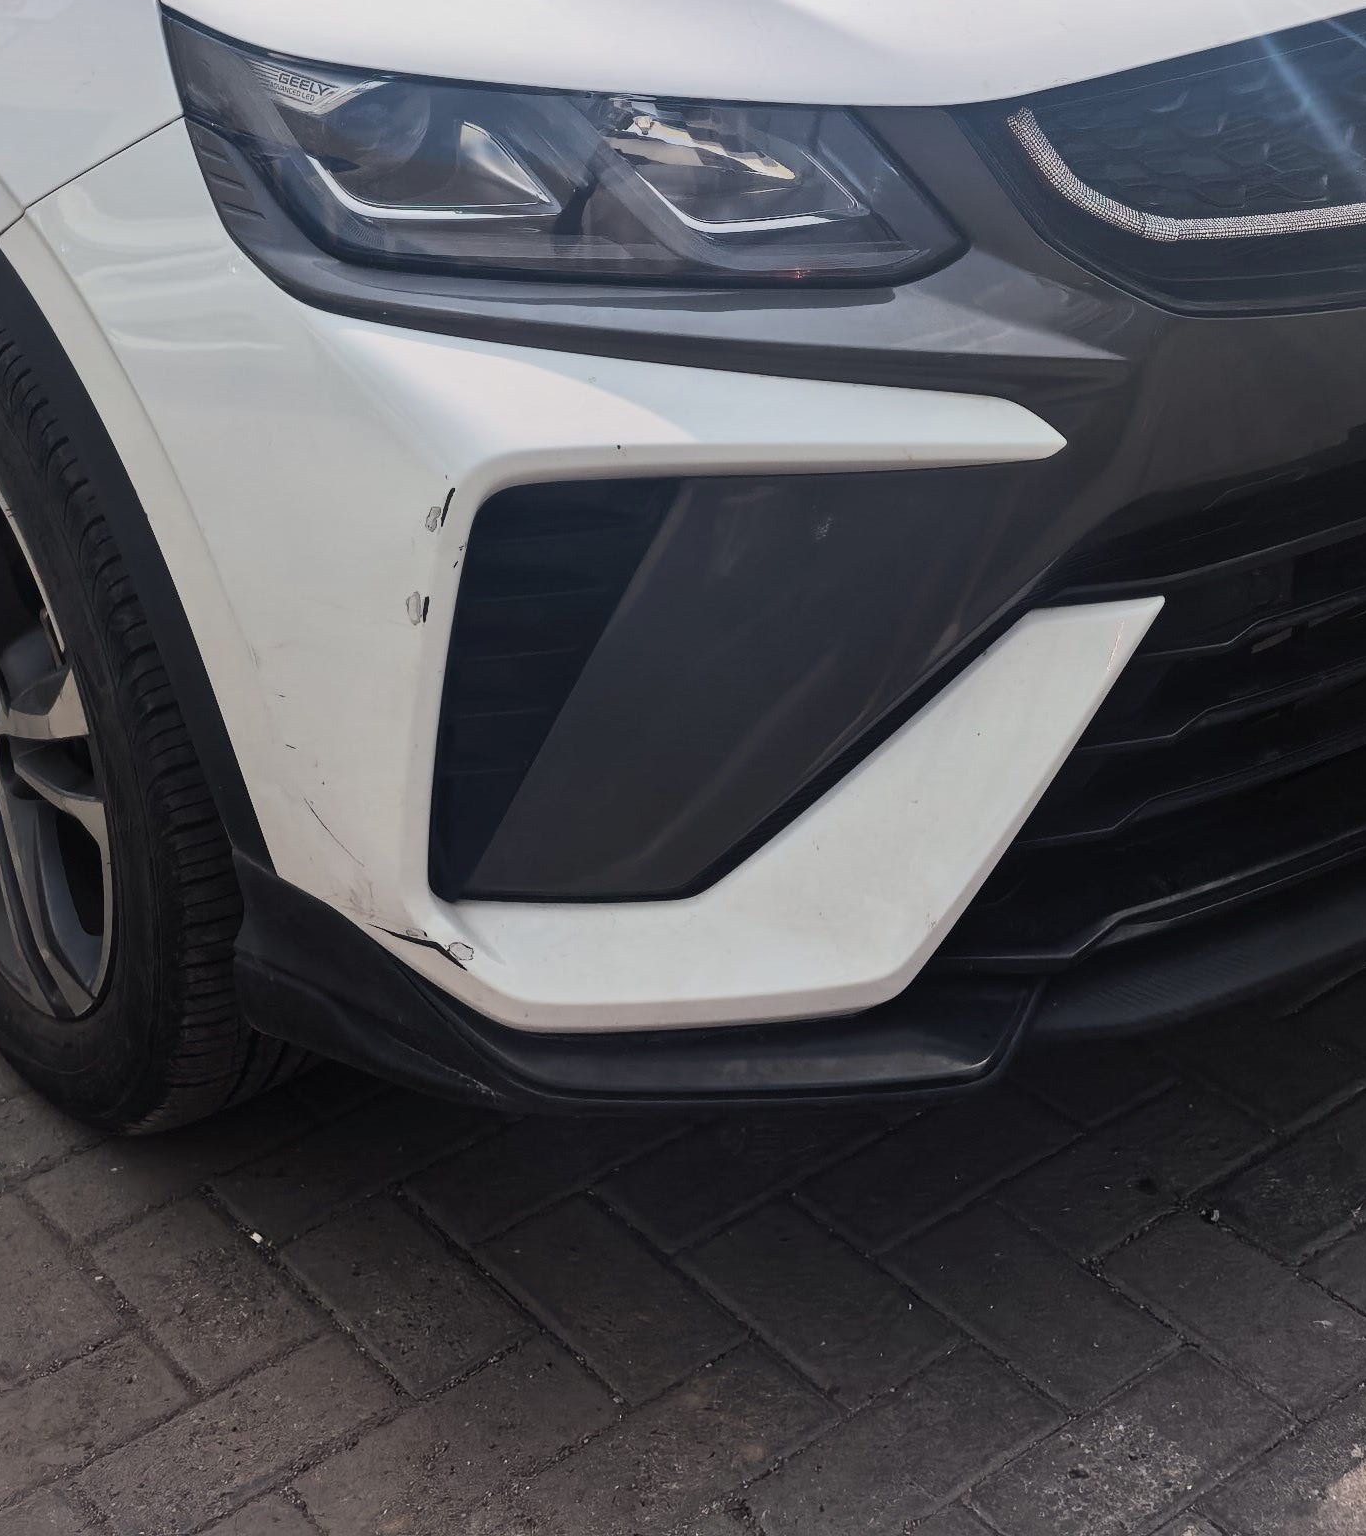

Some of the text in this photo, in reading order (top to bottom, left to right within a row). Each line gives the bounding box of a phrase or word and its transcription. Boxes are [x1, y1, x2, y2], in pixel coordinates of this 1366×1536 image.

[269, 81, 315, 102] ADVANCED LED
[278, 72, 331, 96] GEELY
